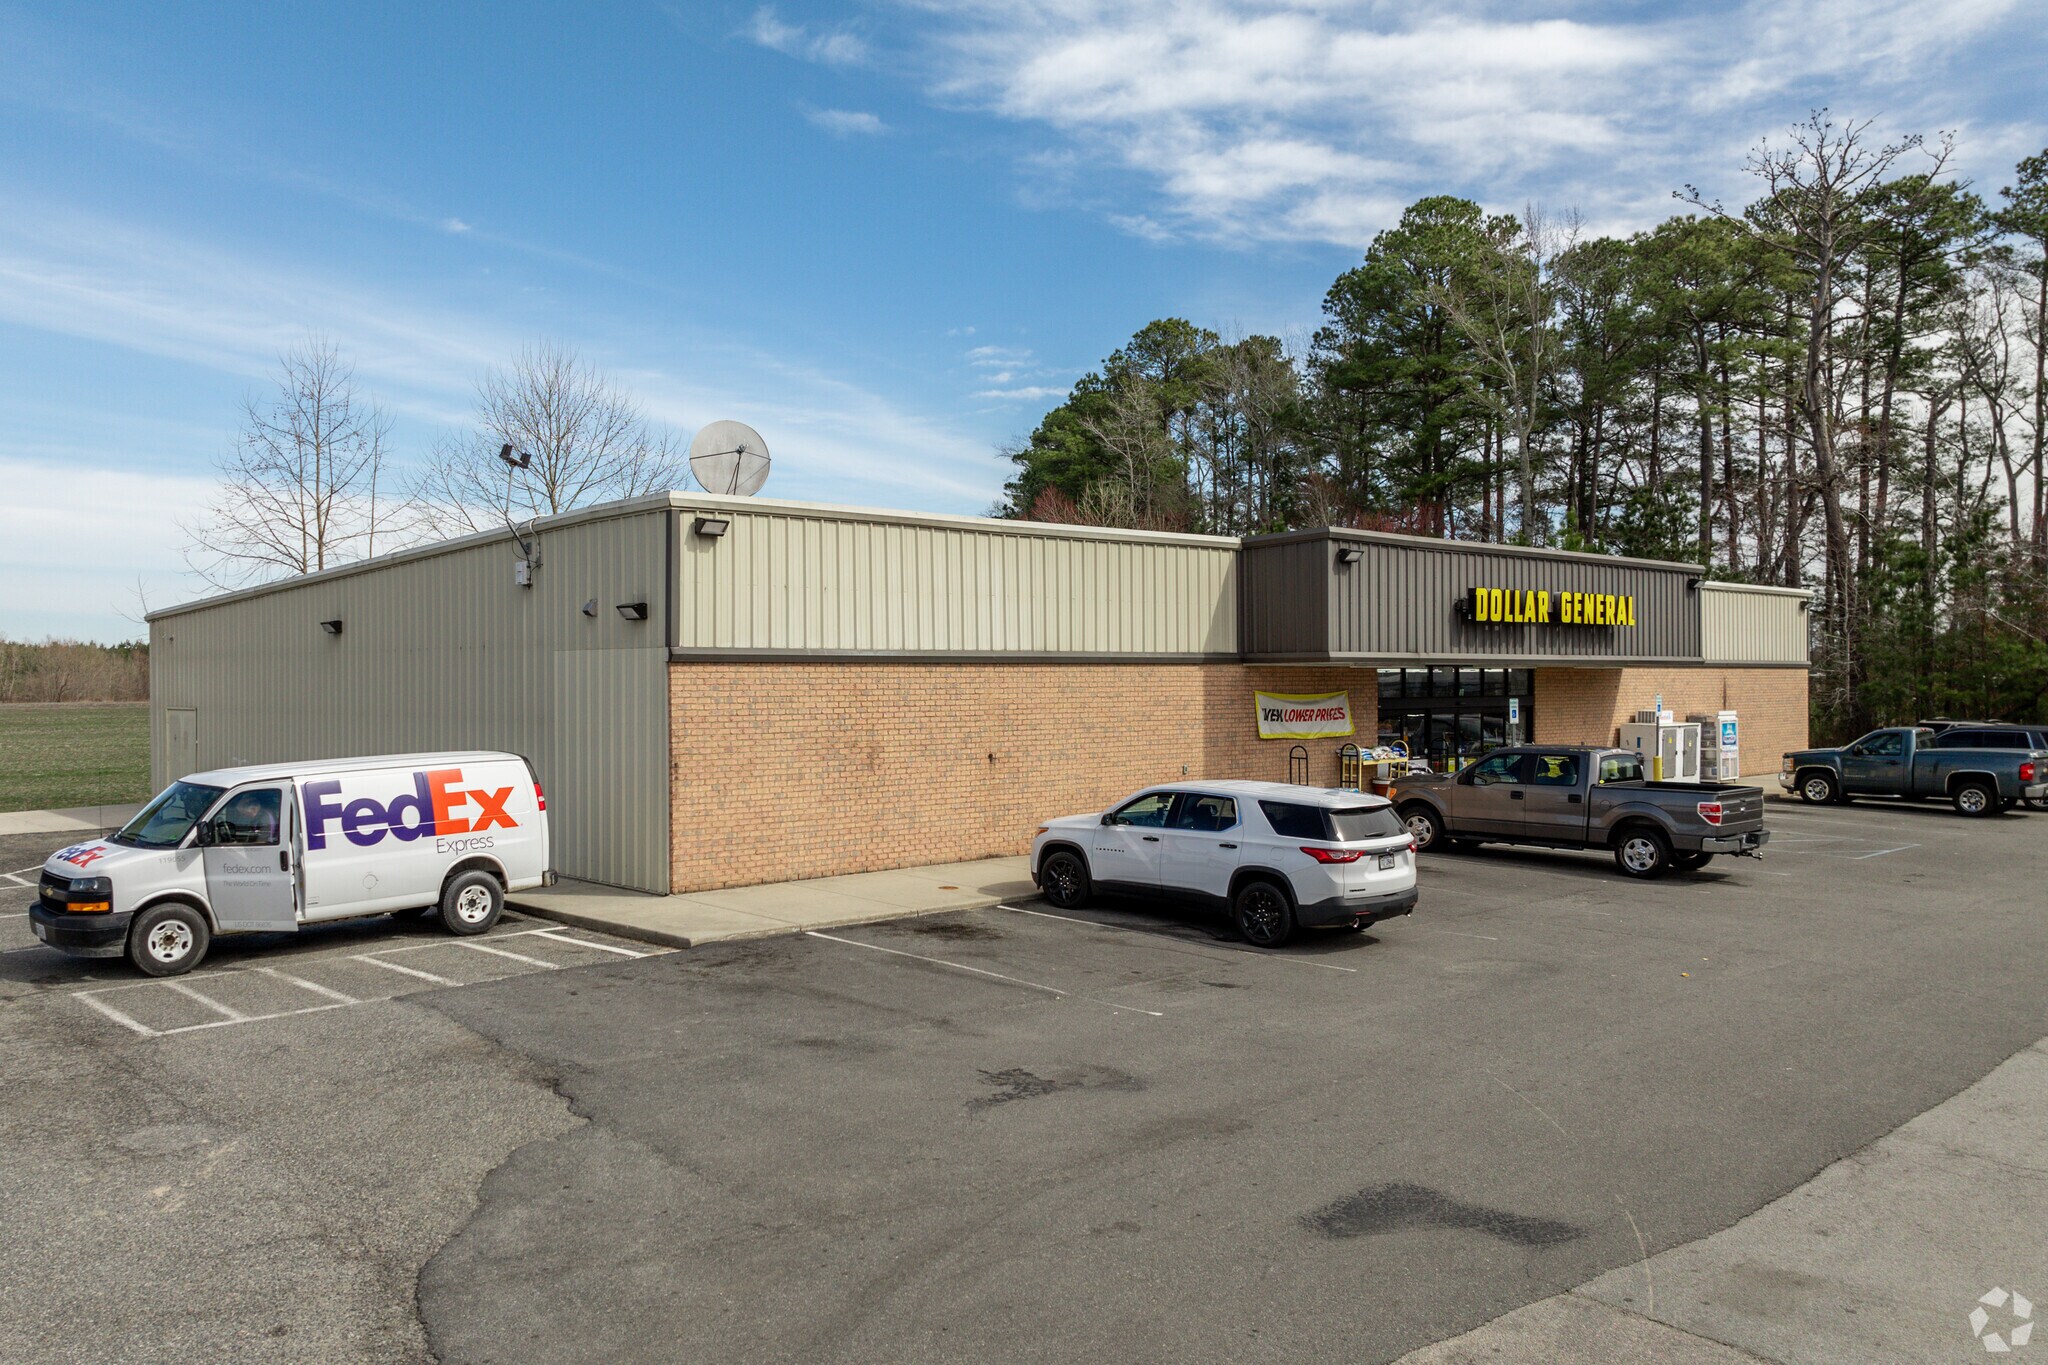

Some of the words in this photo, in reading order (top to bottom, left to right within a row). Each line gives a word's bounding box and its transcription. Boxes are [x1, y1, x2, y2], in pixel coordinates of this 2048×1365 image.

[1475, 587, 1549, 623] DOLLAR
[1560, 591, 1636, 626] GENERAL
[1284, 708, 1315, 723] LOWER
[1315, 707, 1346, 722] PRICES
[301, 767, 519, 851] FedEx
[436, 836, 495, 856] Express
[223, 863, 272, 874] fedex.com
